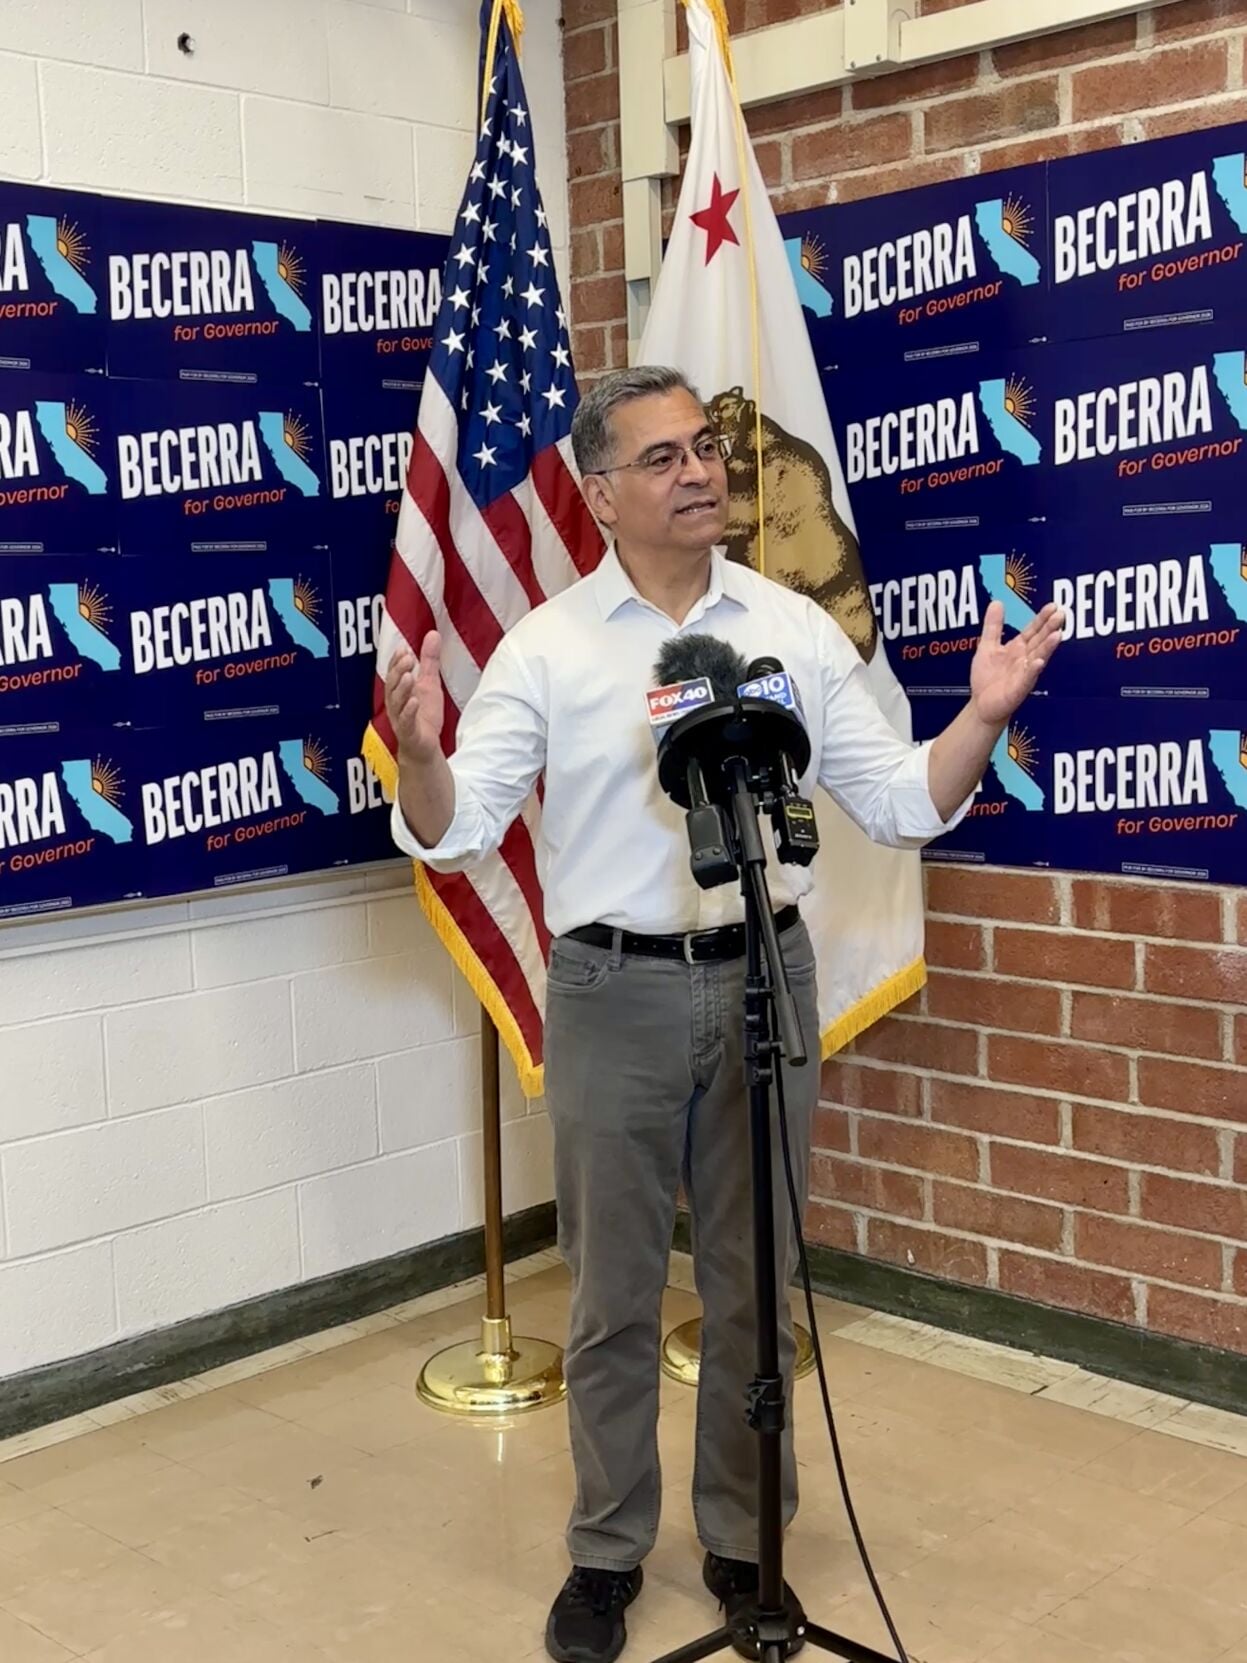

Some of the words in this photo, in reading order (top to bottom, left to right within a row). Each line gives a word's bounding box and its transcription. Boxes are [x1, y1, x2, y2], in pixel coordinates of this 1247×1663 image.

[1055, 170, 1213, 284] BECERRA
[108, 249, 255, 321] BECERRA
[843, 214, 977, 319] BECERRA
[1118, 270, 1147, 291] for
[1150, 242, 1243, 281] Governor
[322, 268, 443, 334] BECERRA
[898, 307, 922, 325] for
[926, 281, 1002, 315] Governor
[173, 325, 201, 341] for
[203, 320, 279, 339] Governor
[376, 339, 398, 353] for
[846, 391, 979, 484] BECERRA
[1054, 365, 1213, 465] BECERRA
[117, 420, 263, 499] BECERRA
[329, 431, 413, 499] BECER
[900, 478, 923, 495] for
[927, 459, 1003, 488] Governor
[1118, 459, 1147, 477] for
[1150, 437, 1243, 470] Governor
[0, 484, 69, 506] overnor
[183, 499, 209, 515] for
[213, 488, 287, 511] Governor
[385, 499, 399, 514] fo
[868, 564, 980, 641] ECERRA
[1053, 554, 1209, 641] BECERRA
[130, 588, 273, 674] BECERRA
[902, 644, 925, 660] for
[928, 636, 980, 656] Gover
[1115, 641, 1145, 659] for
[1148, 629, 1240, 655] Governor
[195, 669, 221, 685] for
[223, 652, 297, 679] Governor
[141, 750, 283, 845] BECERRA
[1053, 738, 1208, 814] BECERRA
[206, 833, 230, 851] for
[234, 809, 307, 843] Governor
[1116, 817, 1145, 835] for
[1148, 813, 1238, 834] Governor
[10, 838, 95, 872] Governor
